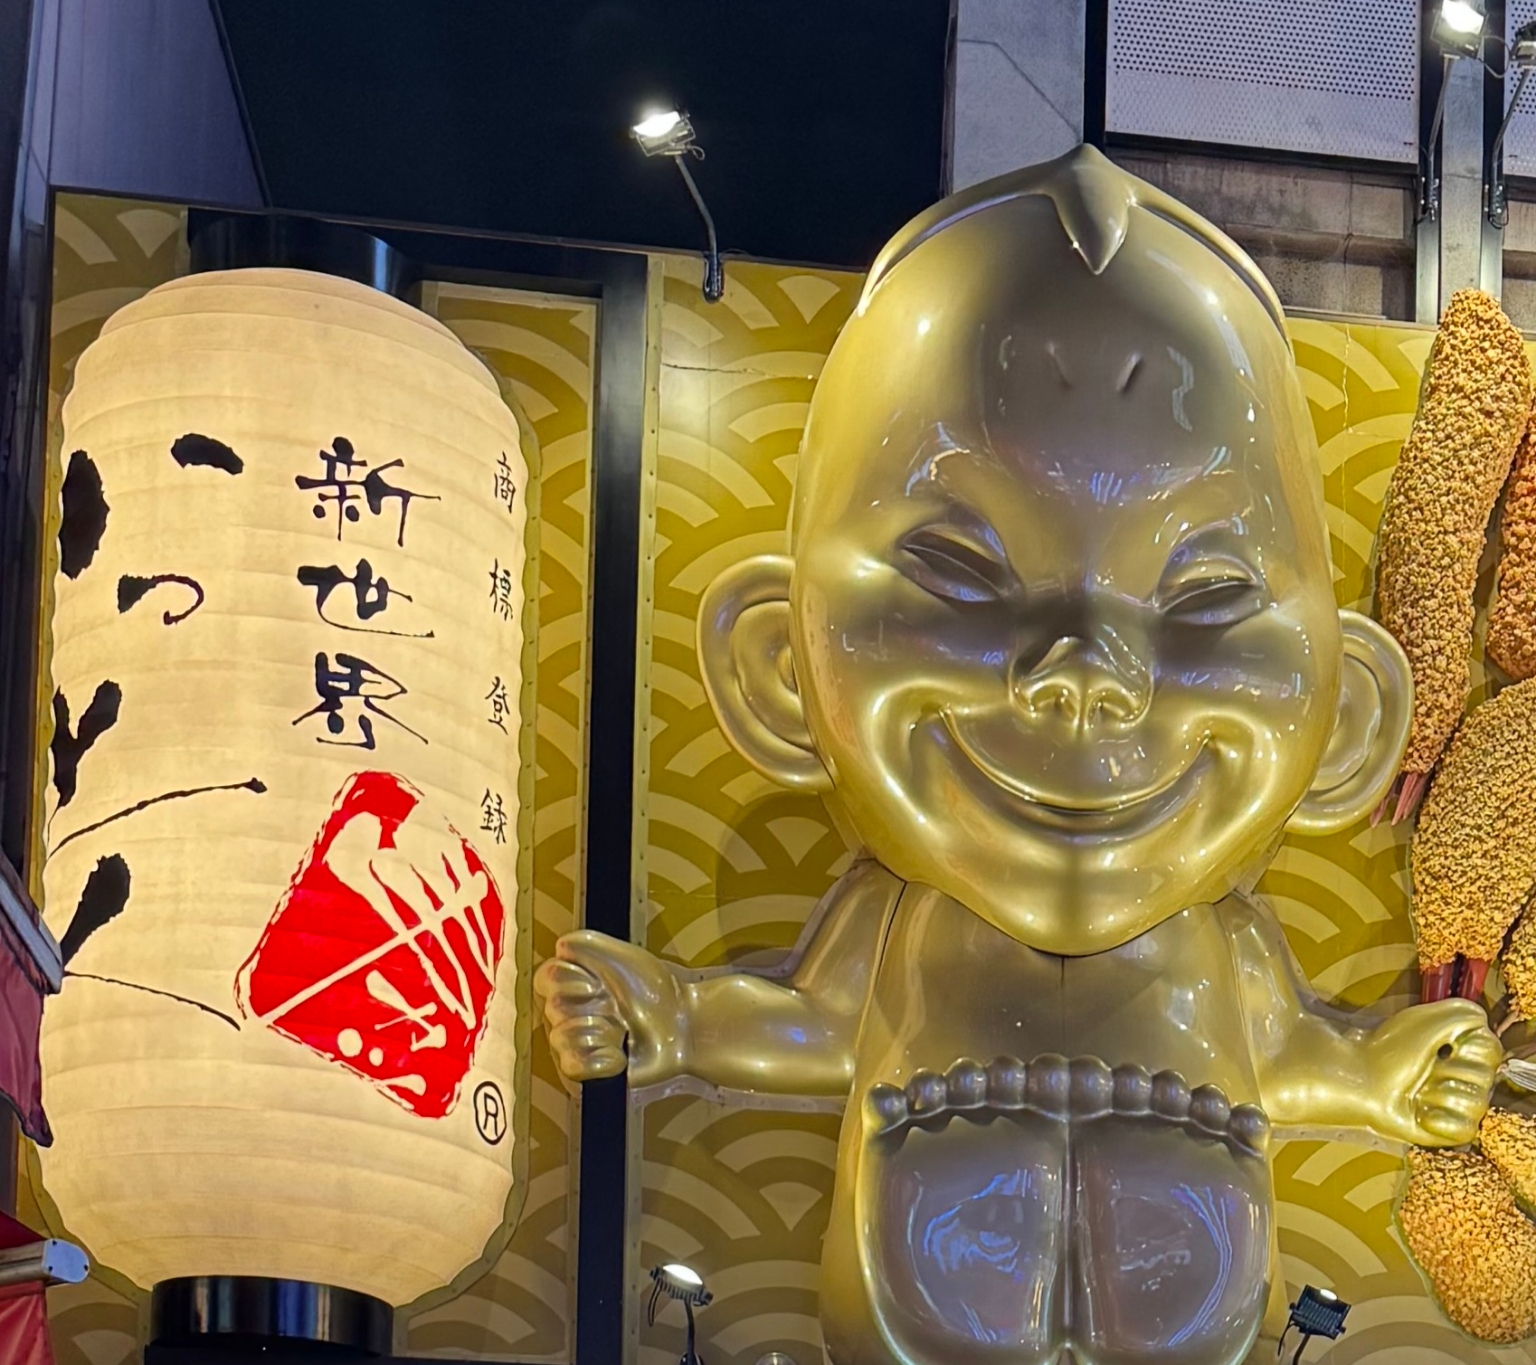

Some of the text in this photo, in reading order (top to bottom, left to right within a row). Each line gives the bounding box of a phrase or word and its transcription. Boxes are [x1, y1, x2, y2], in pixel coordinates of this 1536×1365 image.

[291, 435, 442, 754] 新世界
[479, 449, 518, 850] 商標登録
